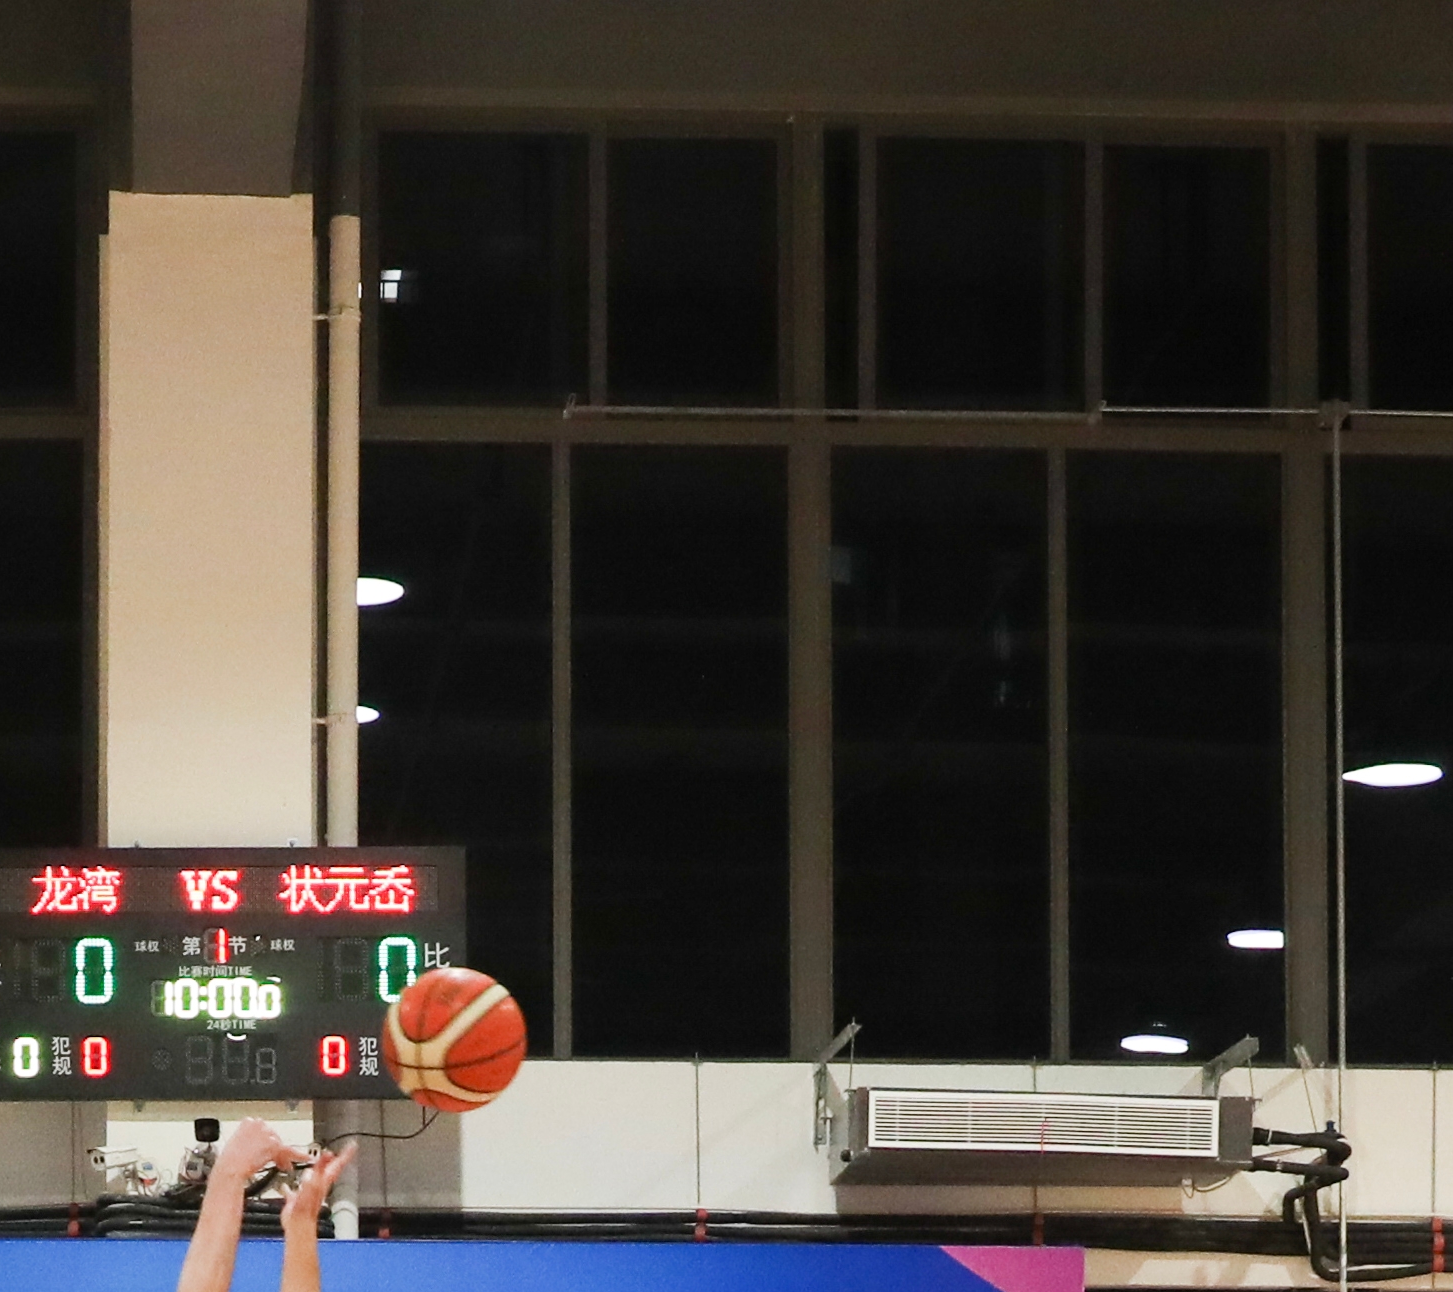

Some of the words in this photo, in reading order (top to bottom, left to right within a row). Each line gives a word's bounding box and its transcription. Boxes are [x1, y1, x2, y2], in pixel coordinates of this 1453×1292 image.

[31, 866, 121, 914] 龙湾
[181, 869, 240, 911] VS
[279, 864, 415, 913] 状元岙
[134, 940, 160, 952] 球权
[270, 939, 296, 951] 球权
[75, 937, 114, 1004] 0
[378, 936, 417, 1003] 0
[12, 1036, 40, 1079] 0
[51, 1036, 72, 1076] 犯规
[83, 1036, 108, 1077] 0
[322, 1036, 346, 1075] 0
[359, 1036, 379, 1077] 犯规
